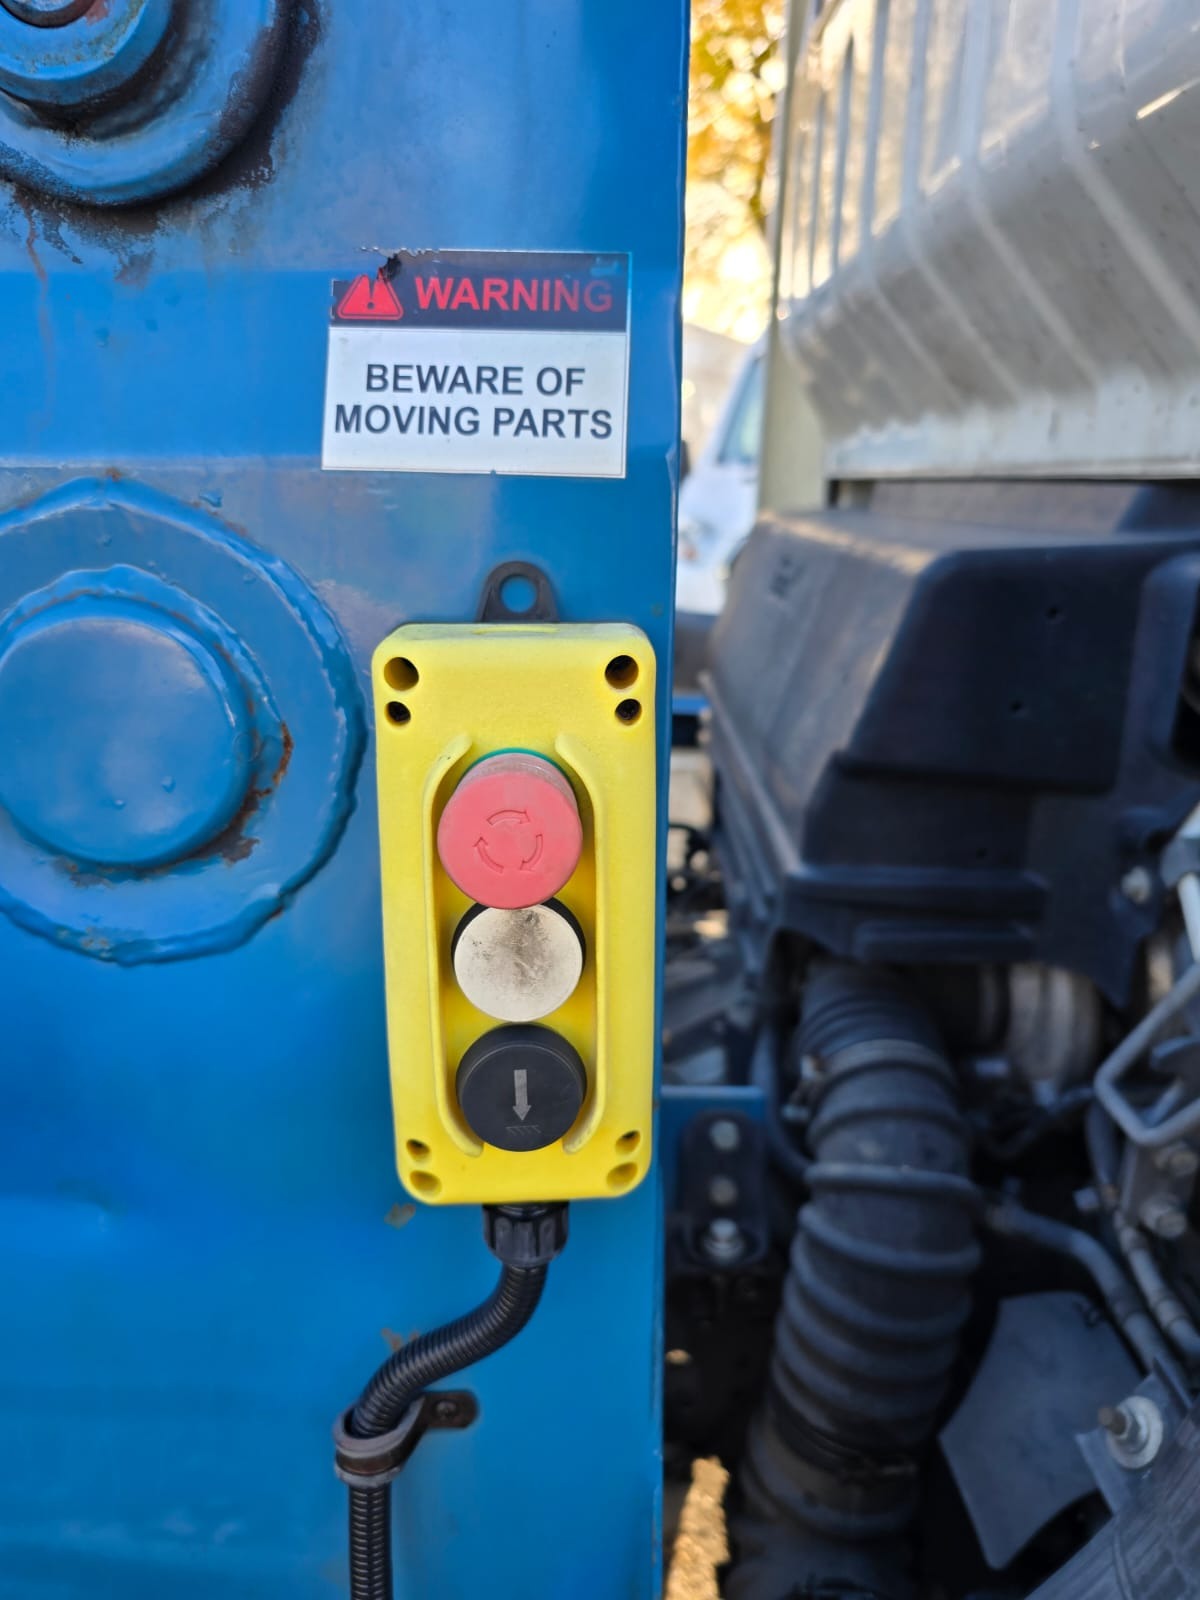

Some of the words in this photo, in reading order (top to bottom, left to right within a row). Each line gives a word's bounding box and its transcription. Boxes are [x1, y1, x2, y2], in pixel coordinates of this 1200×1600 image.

[415, 276, 613, 312] WARNING
[365, 363, 524, 395] BEWARE
[535, 367, 586, 397] OF
[334, 404, 480, 436] MOVING
[493, 408, 613, 440] PARTS
